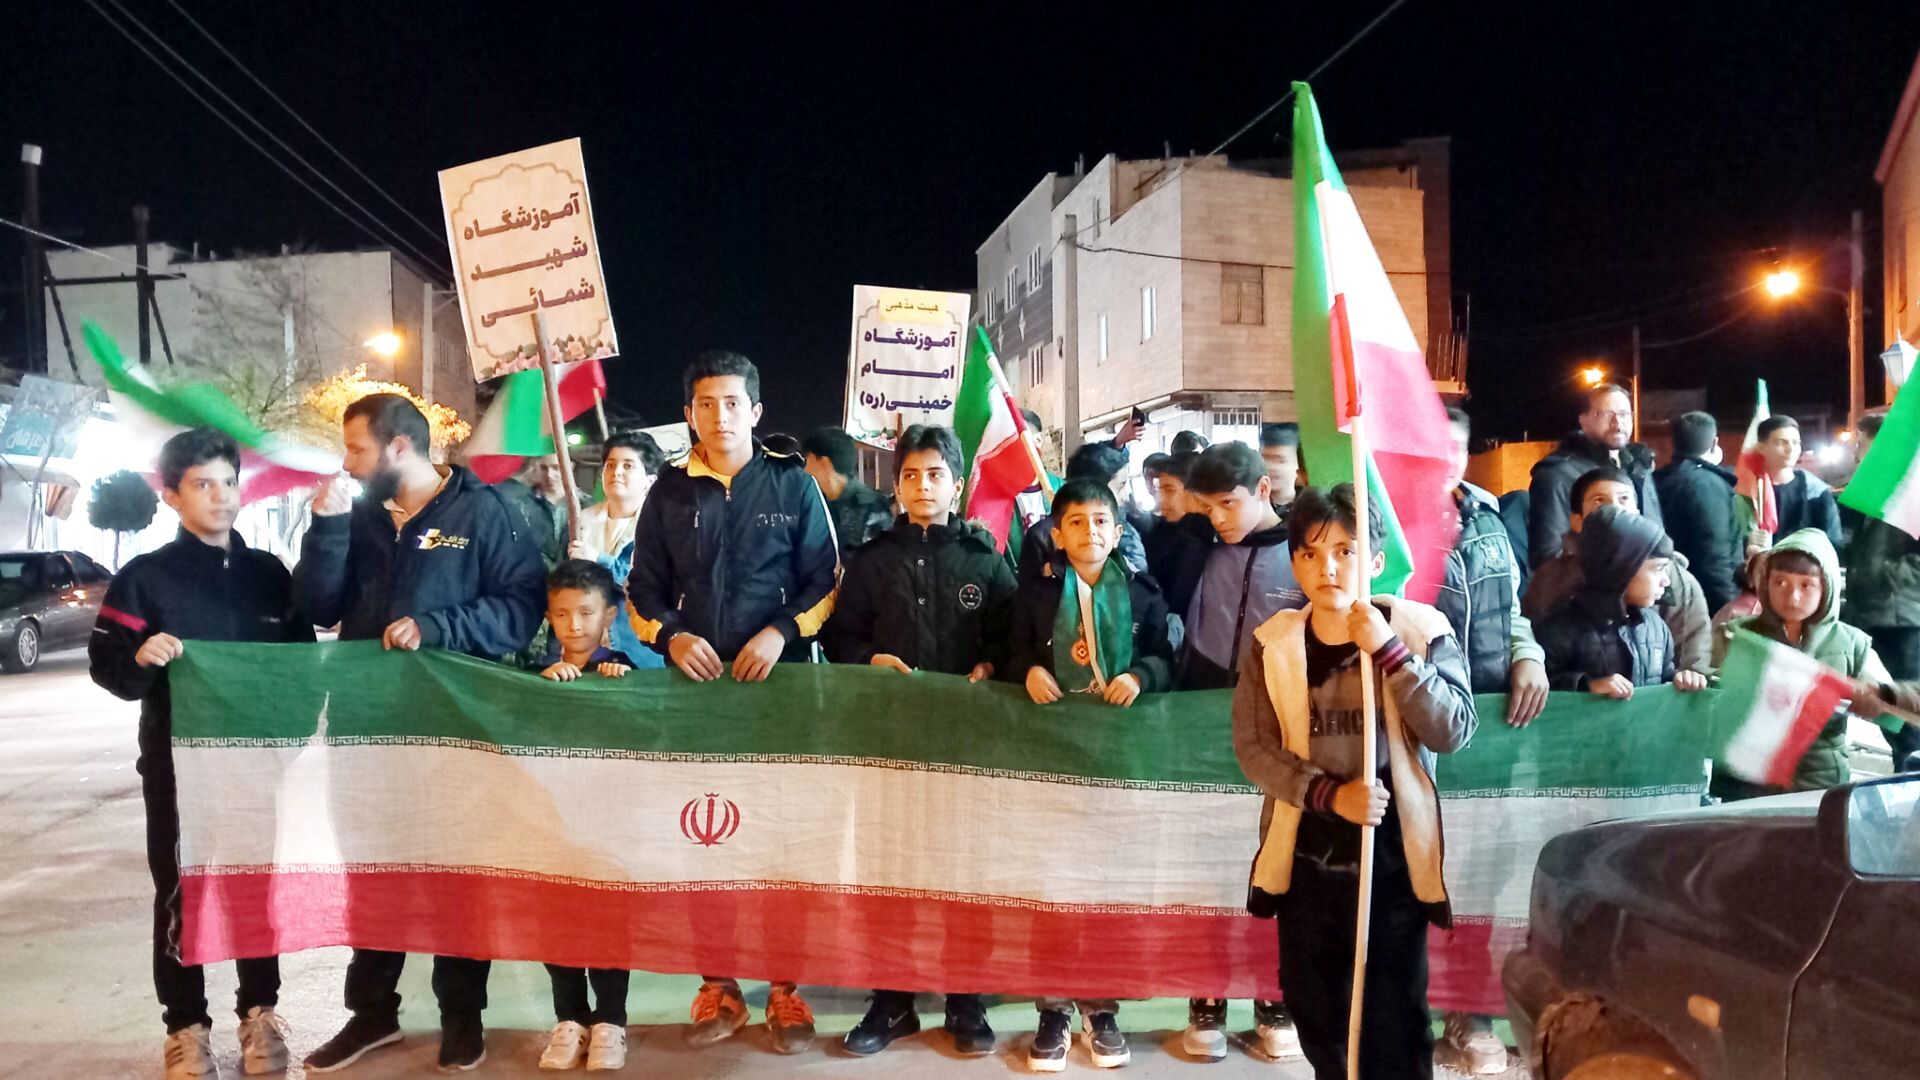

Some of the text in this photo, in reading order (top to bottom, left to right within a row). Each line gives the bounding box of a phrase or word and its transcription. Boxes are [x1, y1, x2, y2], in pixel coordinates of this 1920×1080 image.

[463, 192, 581, 241] آموزشگاه
[470, 235, 589, 282] شهید
[863, 327, 958, 351] آموزشگاه
[861, 359, 955, 379] امام
